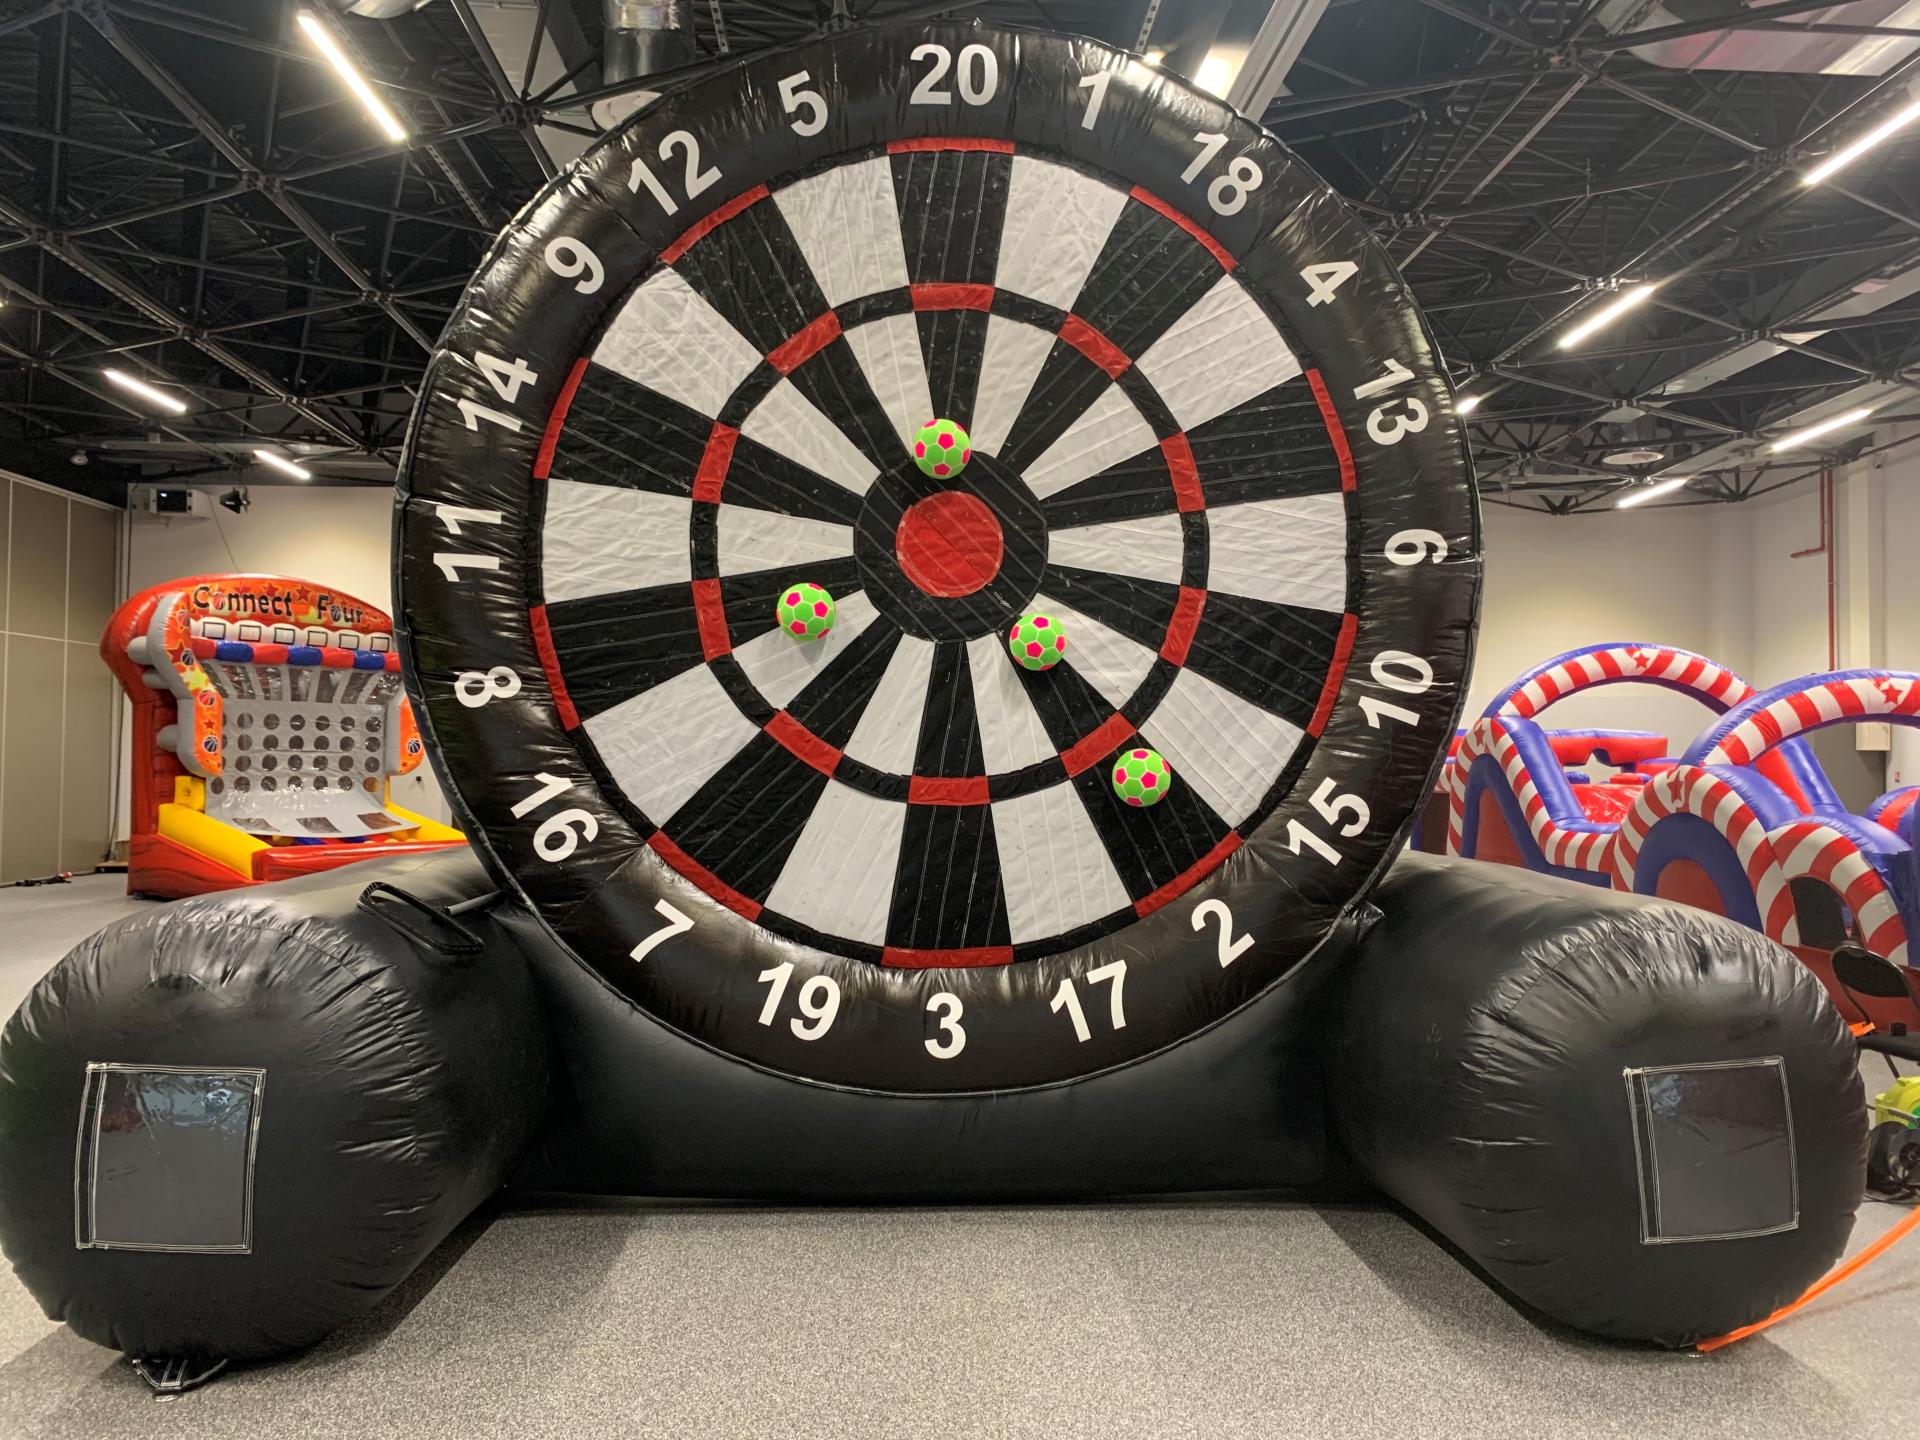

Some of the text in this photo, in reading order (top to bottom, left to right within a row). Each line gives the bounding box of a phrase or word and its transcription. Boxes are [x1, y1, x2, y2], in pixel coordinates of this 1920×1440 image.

[778, 70, 828, 137] 5
[910, 43, 998, 105] 20
[1078, 70, 1110, 131] 1
[628, 130, 722, 216] 12
[1180, 131, 1263, 216] 18
[545, 236, 605, 295] 9
[1299, 261, 1358, 308] 4
[457, 351, 538, 433] 14
[1353, 358, 1429, 446] 13
[432, 504, 502, 583] 11
[1384, 528, 1448, 566] 6
[454, 665, 522, 708] 8
[1358, 650, 1434, 729] 10
[510, 772, 599, 862] 16
[1285, 776, 1370, 867] 15
[629, 899, 695, 962] 7
[1191, 898, 1255, 968] 2
[757, 961, 841, 1041] 19
[924, 992, 967, 1059] 3
[1050, 959, 1128, 1042] 17
